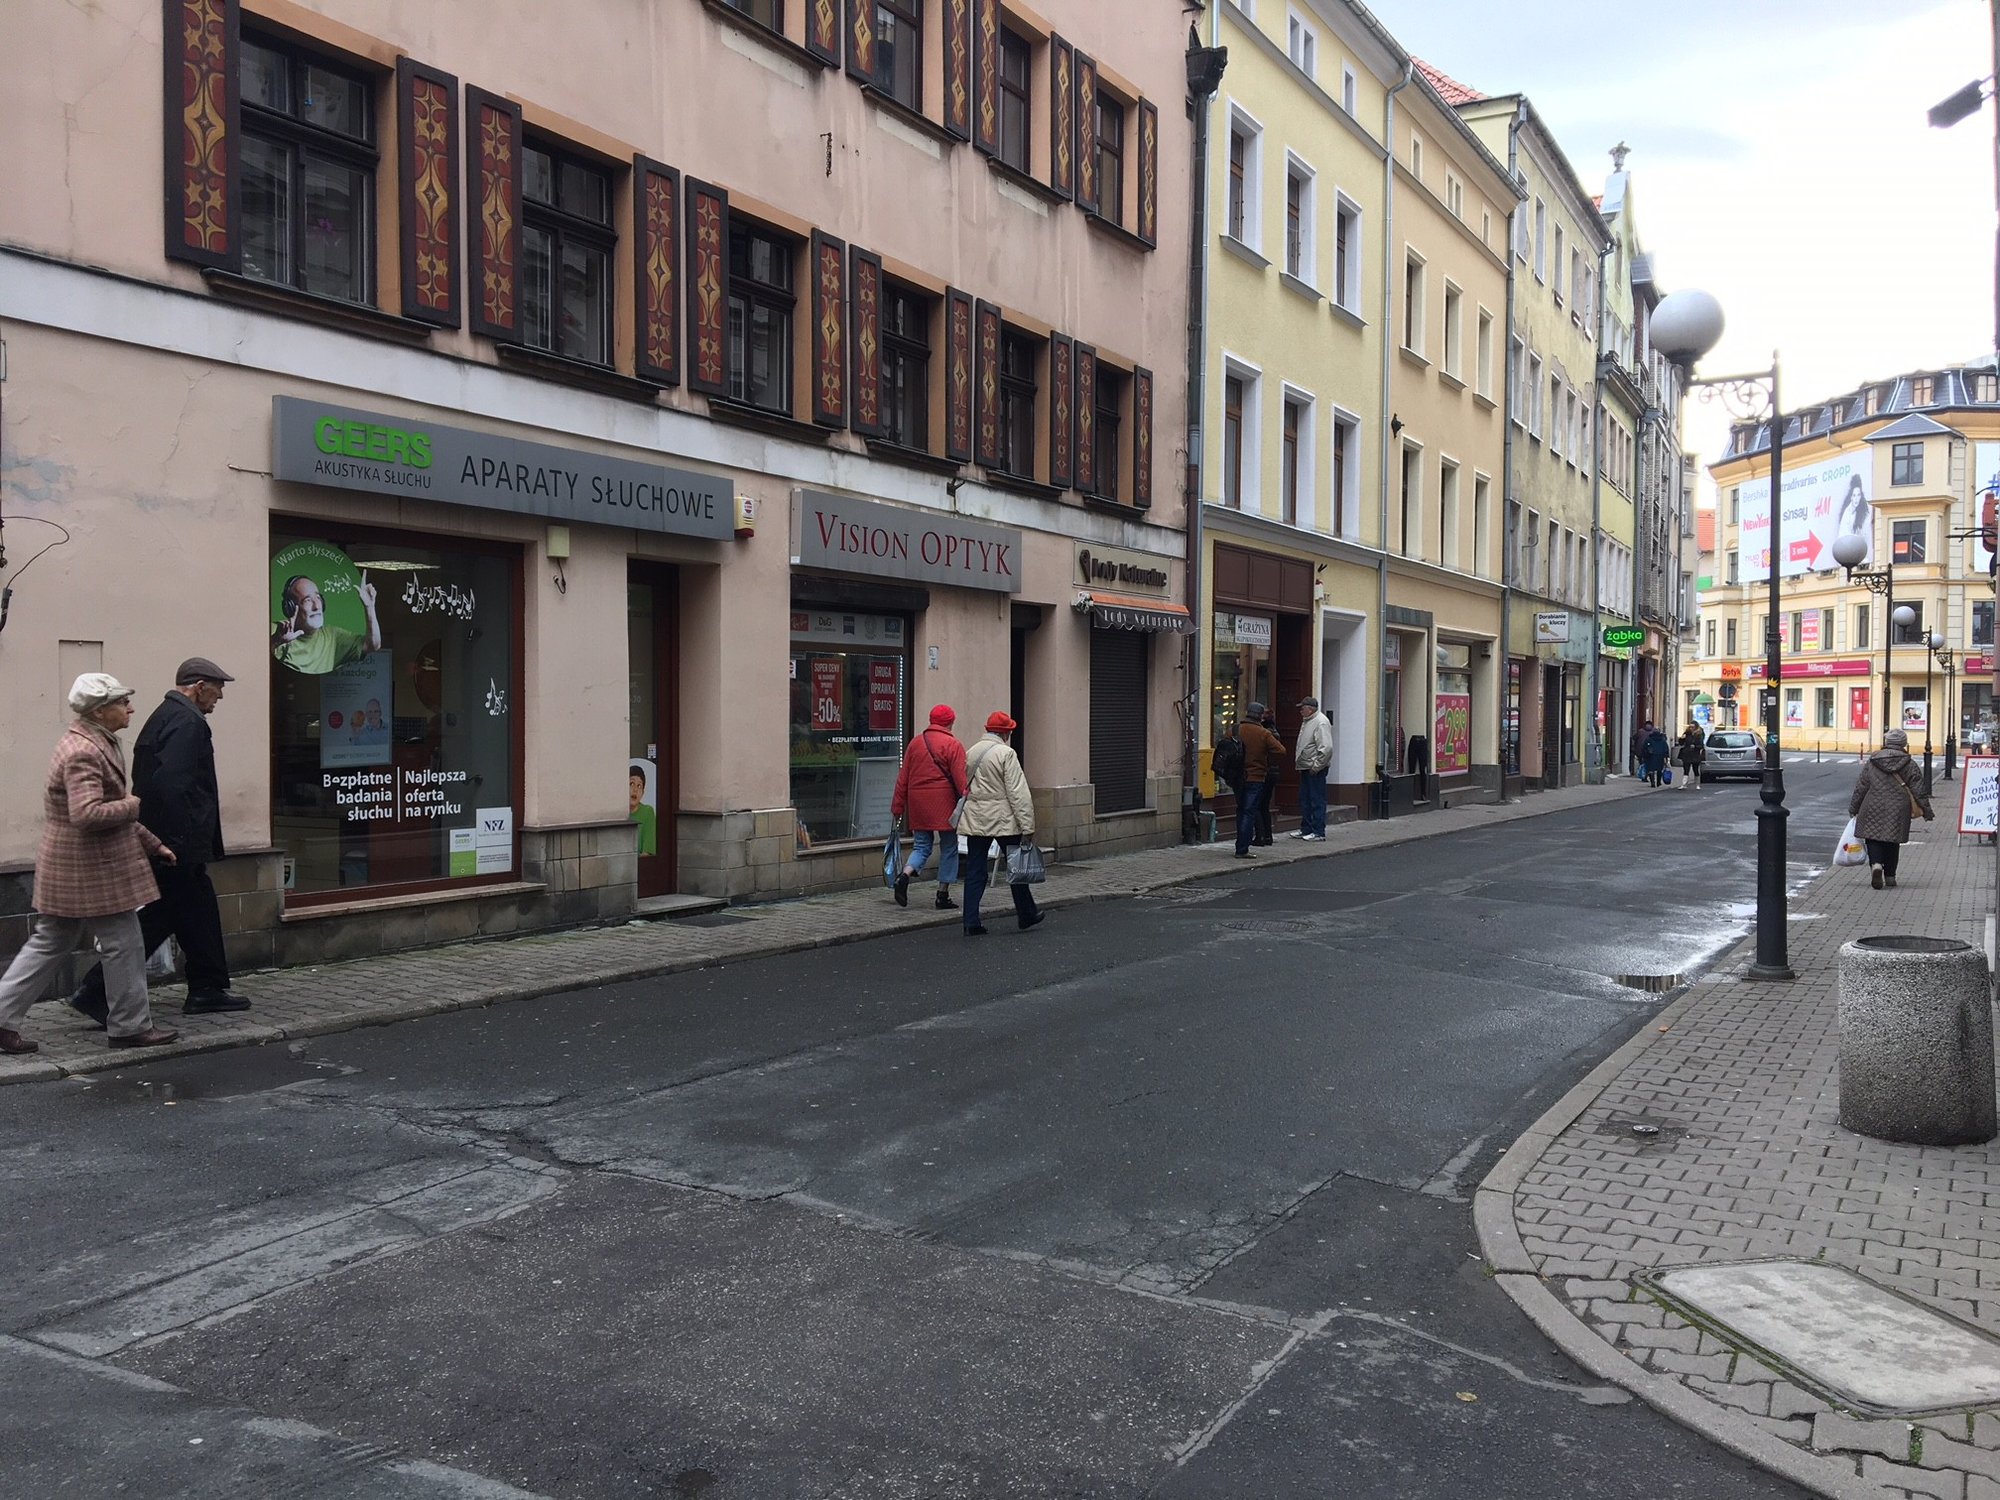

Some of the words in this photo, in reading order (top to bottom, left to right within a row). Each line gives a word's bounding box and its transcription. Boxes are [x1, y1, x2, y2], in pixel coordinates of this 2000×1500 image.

[314, 416, 433, 469] GEERS
[314, 460, 381, 482] AKUSTYKA
[384, 469, 431, 489] SŁUCHU
[460, 455, 578, 500] APARATY
[591, 476, 714, 519] SŁUCHOWE
[1742, 488, 1769, 503] Bershka
[1780, 473, 1818, 492] tradivarius
[1822, 464, 1851, 482] CROPP
[1783, 506, 1808, 522] sinsay
[815, 511, 910, 560] VISION
[921, 531, 1012, 575] OPTYK
[276, 546, 306, 567] Warto
[307, 543, 344, 566] słyszeć!
[1243, 622, 1270, 635] GRAŻYNA
[1606, 630, 1642, 641] żabka
[874, 665, 892, 677] DRUGA
[1722, 667, 1741, 677] Optyk
[871, 682, 896, 695] OPRAWKA
[813, 697, 840, 723] -50%
[1970, 761, 1999, 769] ZAPRAS
[405, 769, 466, 786] Najlepsza
[1981, 776, 1995, 785] NA
[336, 788, 392, 804] badania
[405, 788, 444, 803] oferta
[1971, 792, 1998, 804] DOMO
[347, 805, 392, 821] słuchu
[405, 806, 421, 817] na
[424, 801, 461, 819] rynku
[484, 819, 505, 832] NFZ
